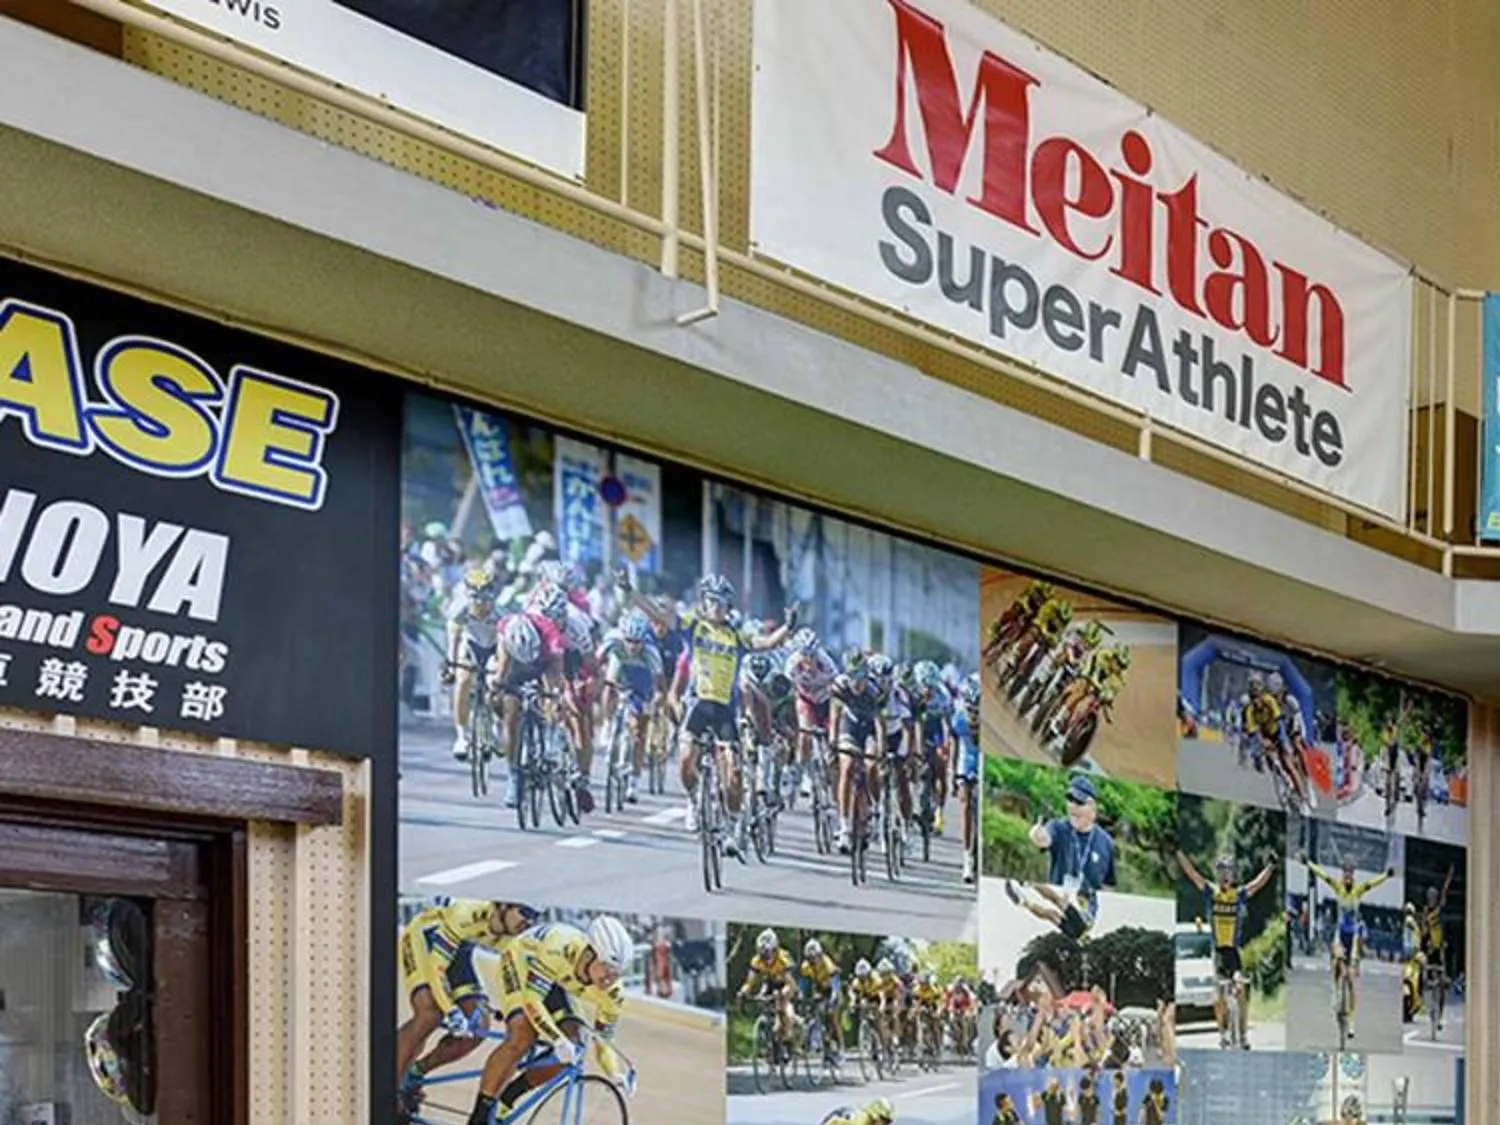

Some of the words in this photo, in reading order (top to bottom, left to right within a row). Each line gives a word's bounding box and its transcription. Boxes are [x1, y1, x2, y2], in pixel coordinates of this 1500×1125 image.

[208, 0, 281, 30] WIS
[873, 0, 1352, 394] Meitan
[0, 604, 85, 649] and
[86, 614, 229, 673] Sports
